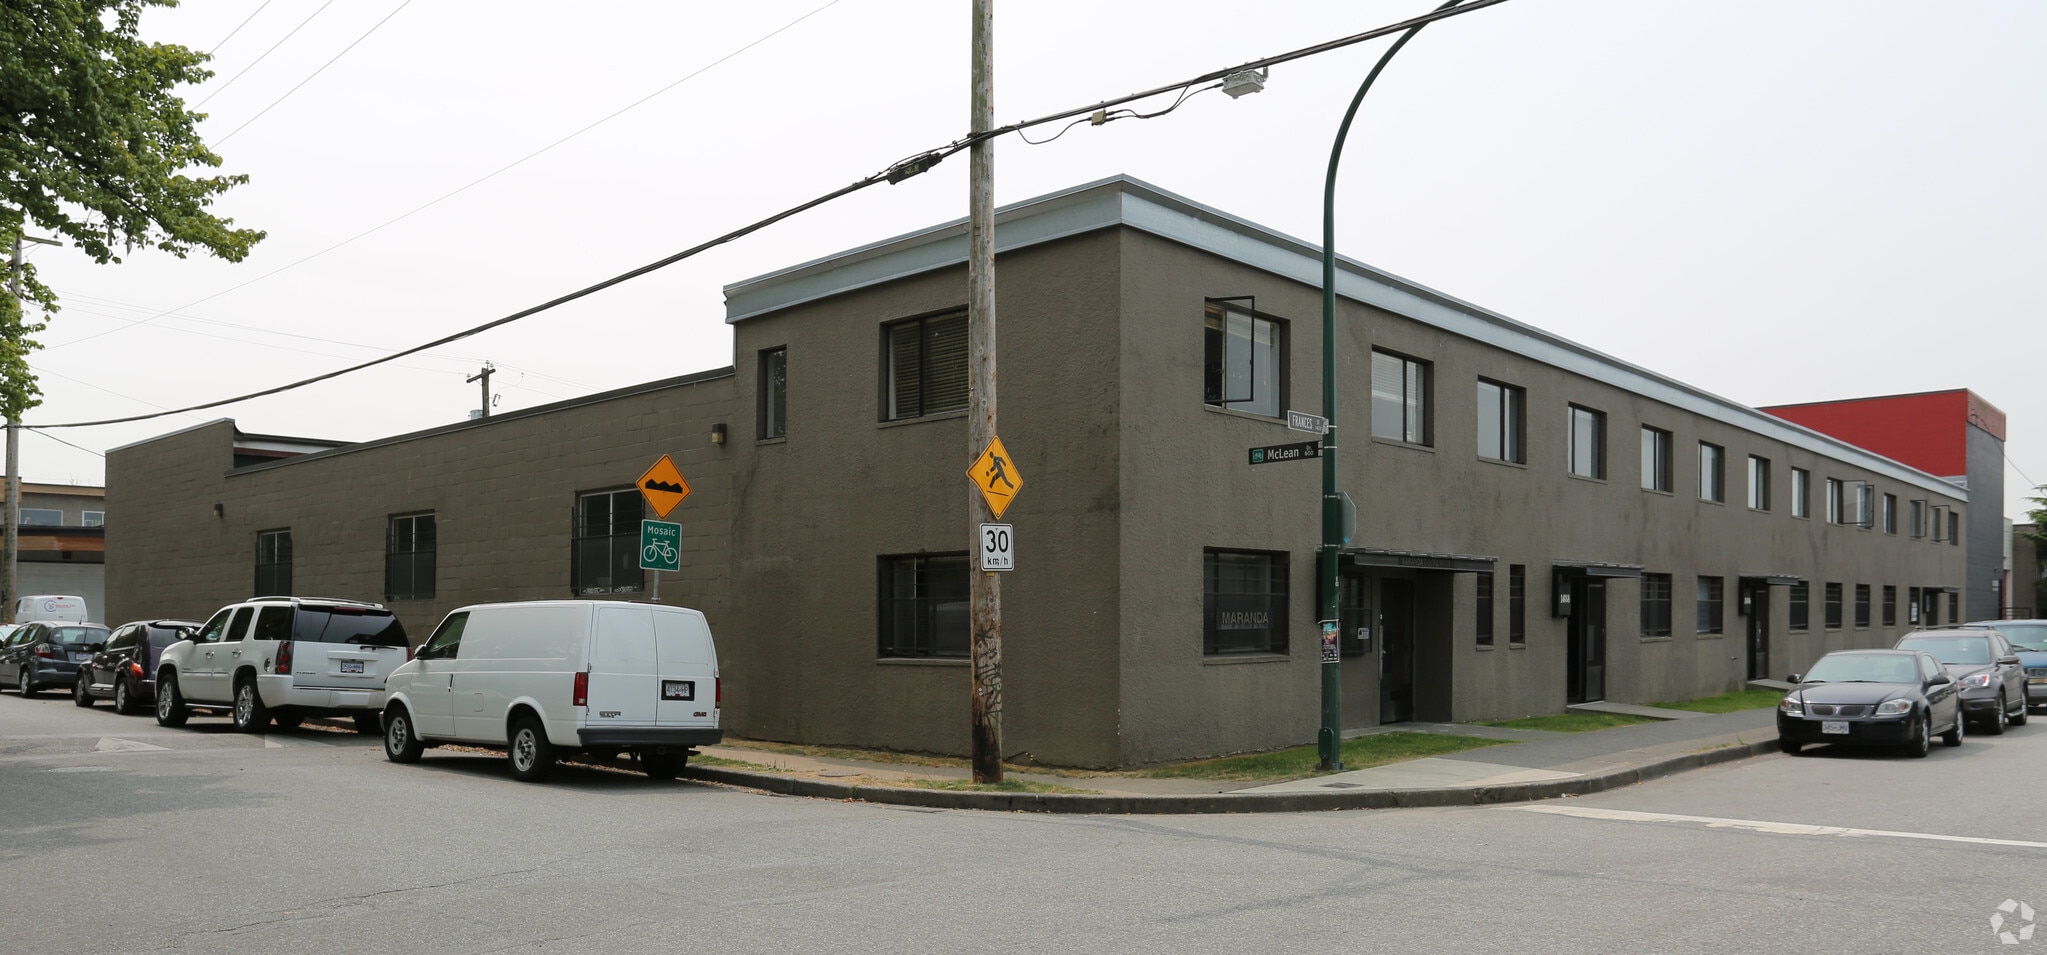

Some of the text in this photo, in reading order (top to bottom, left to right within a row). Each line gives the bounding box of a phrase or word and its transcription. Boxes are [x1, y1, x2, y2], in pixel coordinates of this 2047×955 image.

[1292, 414, 1313, 430] FRANCES
[1267, 448, 1299, 460] McLean
[647, 525, 676, 537] Mosaic
[986, 530, 1008, 553] 30
[987, 555, 1009, 567] km/h
[1221, 611, 1269, 625] MARANDA
